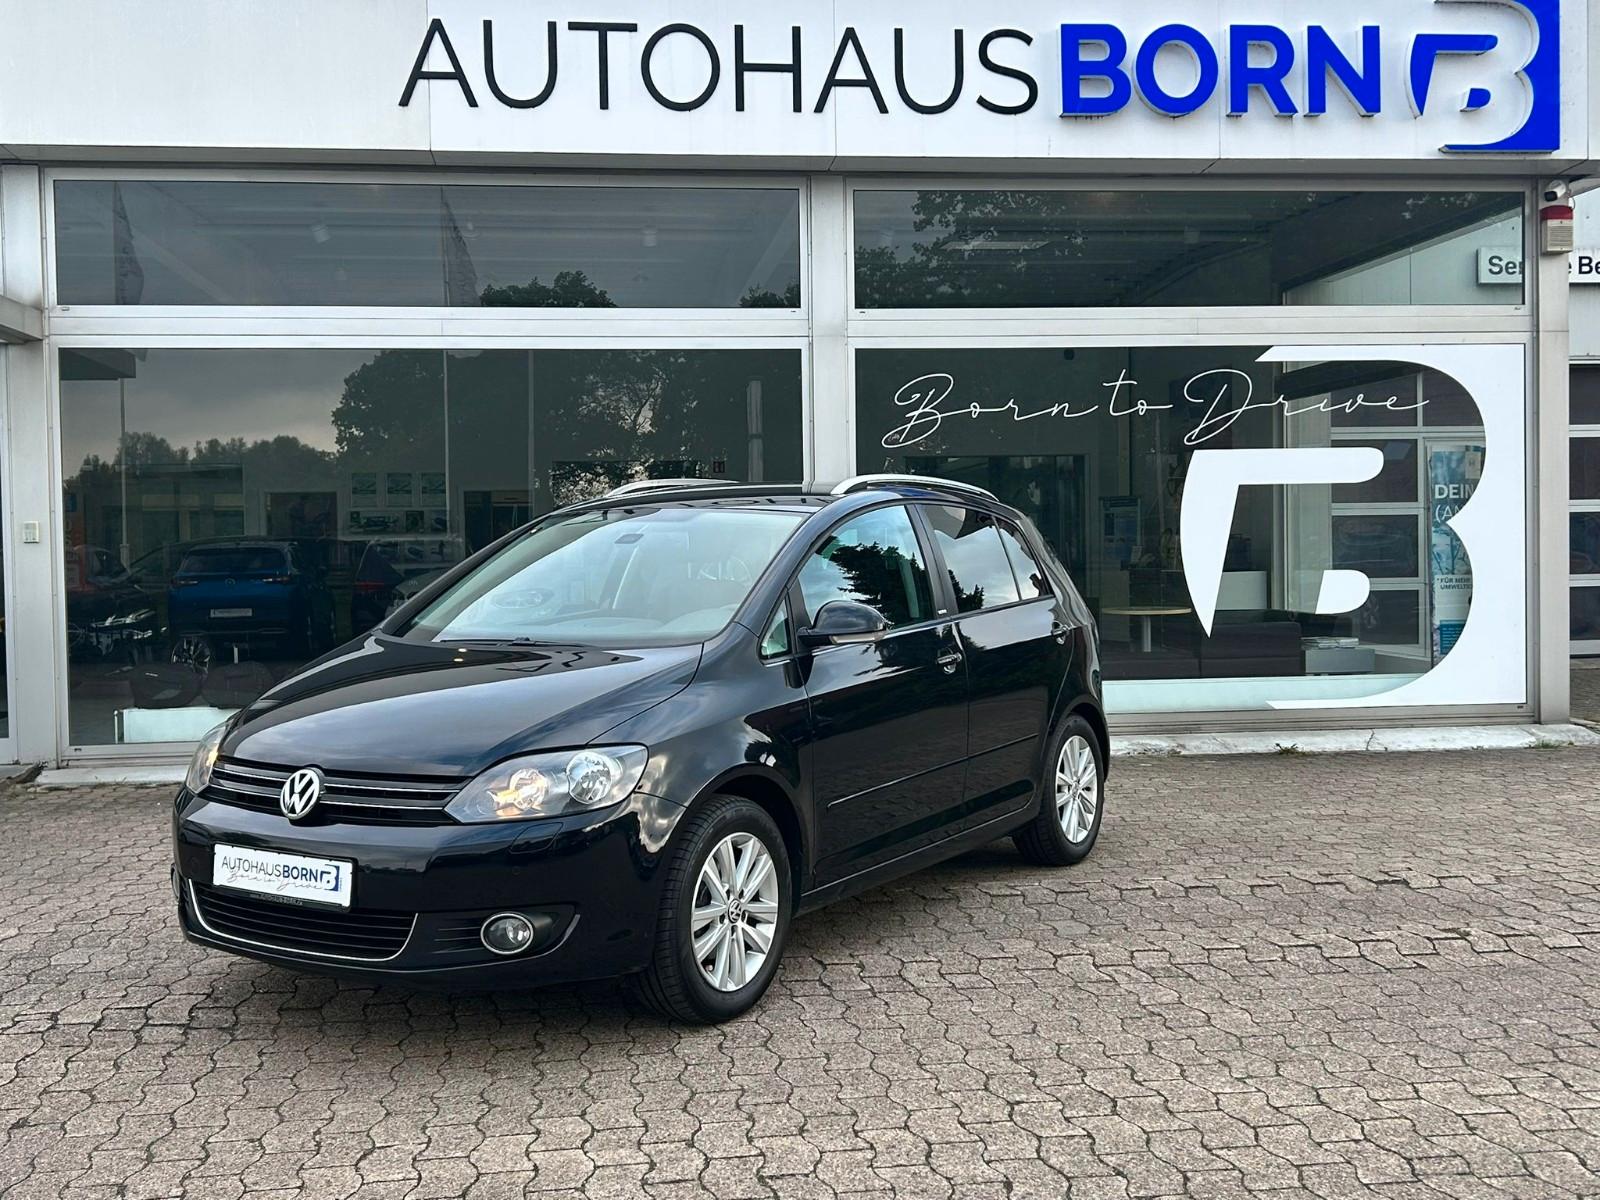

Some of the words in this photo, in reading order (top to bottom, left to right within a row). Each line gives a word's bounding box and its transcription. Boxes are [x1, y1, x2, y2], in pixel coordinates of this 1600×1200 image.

[881, 373, 1099, 448] Born
[1102, 369, 1173, 416] to
[1184, 368, 1429, 446] Drive
